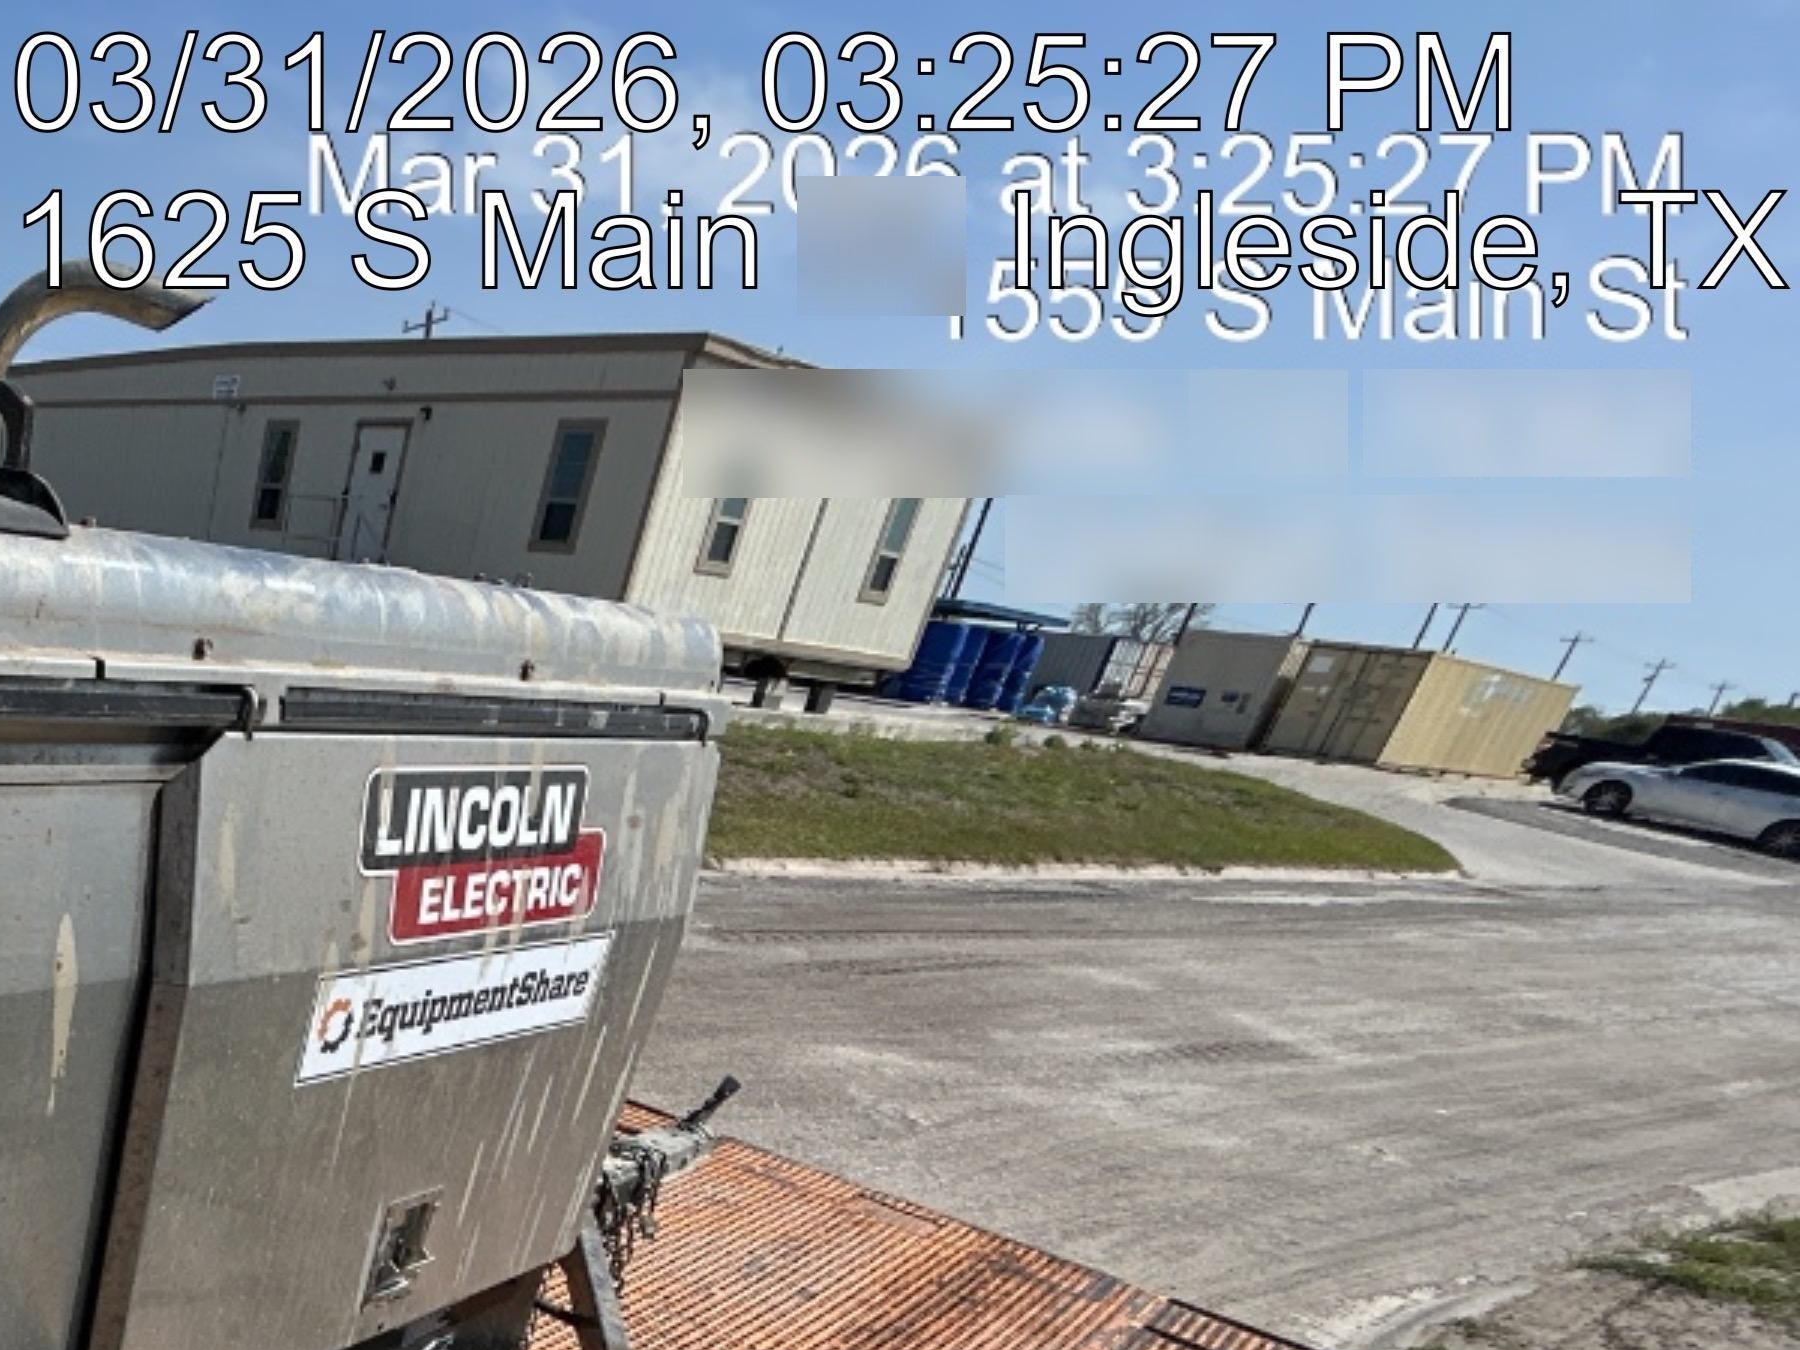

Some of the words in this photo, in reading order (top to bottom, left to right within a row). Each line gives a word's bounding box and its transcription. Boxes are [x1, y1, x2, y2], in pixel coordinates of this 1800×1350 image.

[374, 782, 578, 857] LINCOLN
[416, 862, 585, 926] ELECTRIC
[355, 967, 590, 1043] EquipmentShare
